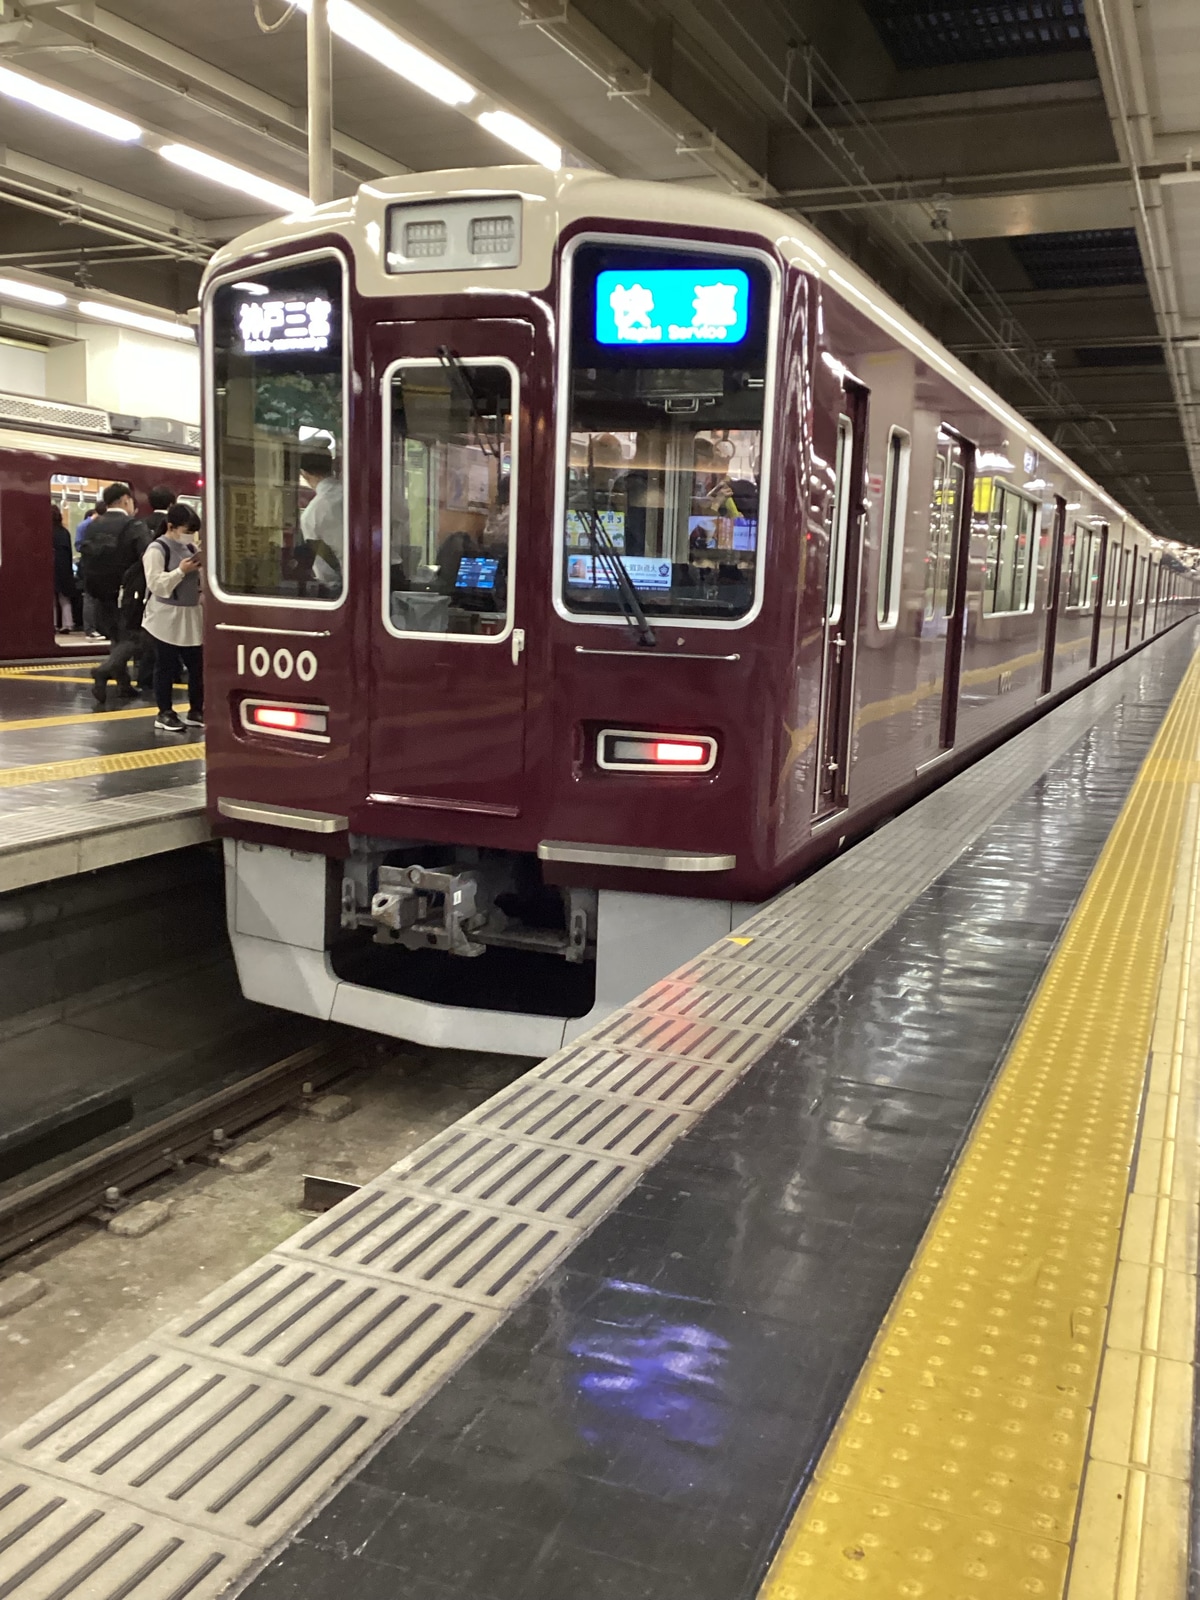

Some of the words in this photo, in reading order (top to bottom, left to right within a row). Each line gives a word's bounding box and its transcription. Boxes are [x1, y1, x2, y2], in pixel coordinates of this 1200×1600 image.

[239, 297, 331, 339] 神戸三宮
[668, 324, 728, 341] Service
[237, 644, 318, 682] 1000
